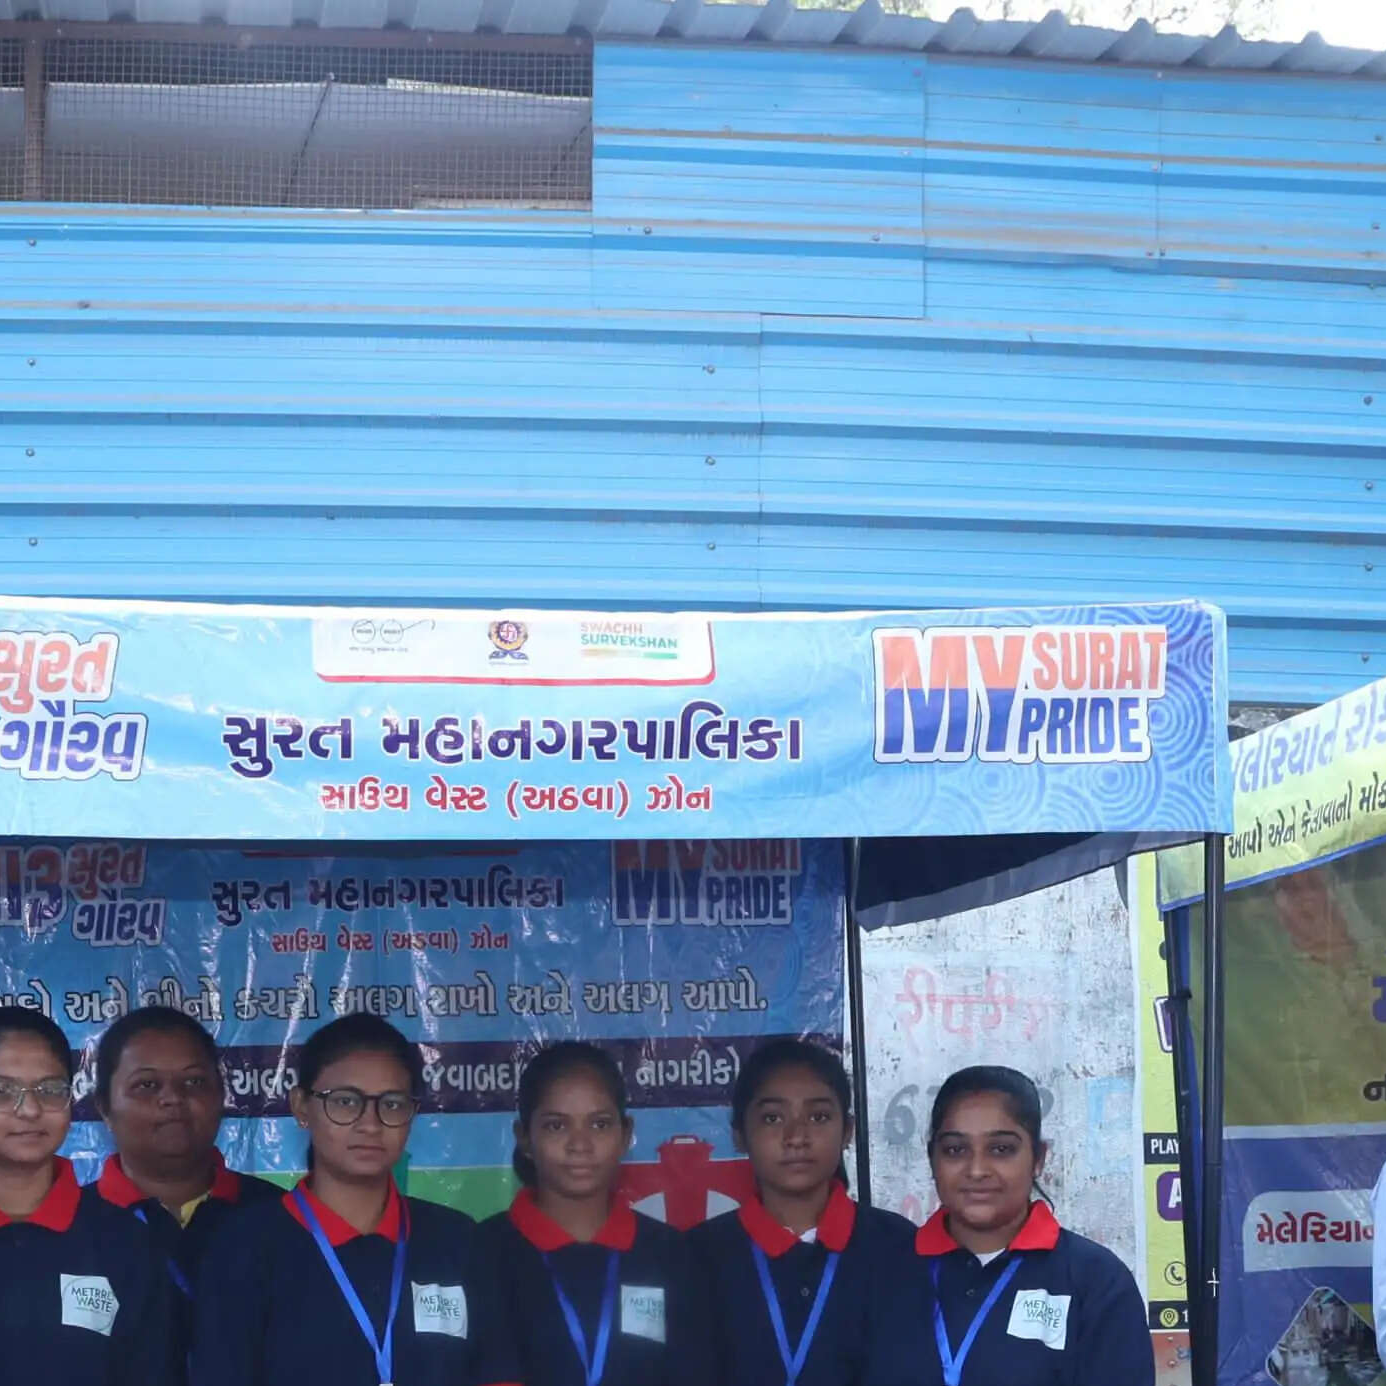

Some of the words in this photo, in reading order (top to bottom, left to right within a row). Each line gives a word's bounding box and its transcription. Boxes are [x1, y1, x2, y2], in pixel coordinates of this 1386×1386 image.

[581, 633, 678, 648] SURVEKSHAN
[1033, 631, 1166, 692] SURAT
[880, 635, 1026, 755] MY
[222, 715, 352, 777] સુરત
[385, 700, 803, 762] મહાનગરપાલિકા
[1019, 698, 1143, 755] PRIDE
[320, 783, 409, 812] સાઉથ
[425, 776, 488, 812] વેસ્ટ
[508, 781, 629, 819] (અઠવા)
[647, 776, 712, 811] ઝોન
[213, 876, 292, 927] સુરત
[309, 864, 564, 910] મહાનગરપાલિકા
[713, 876, 789, 919] PRIDE
[272, 929, 326, 951] સાઉથ
[337, 925, 373, 951] વેસ્ટ
[469, 923, 508, 949] ઝોન
[65, 978, 128, 1022] અને
[508, 970, 571, 1015] અને
[583, 983, 669, 1014] અલગ
